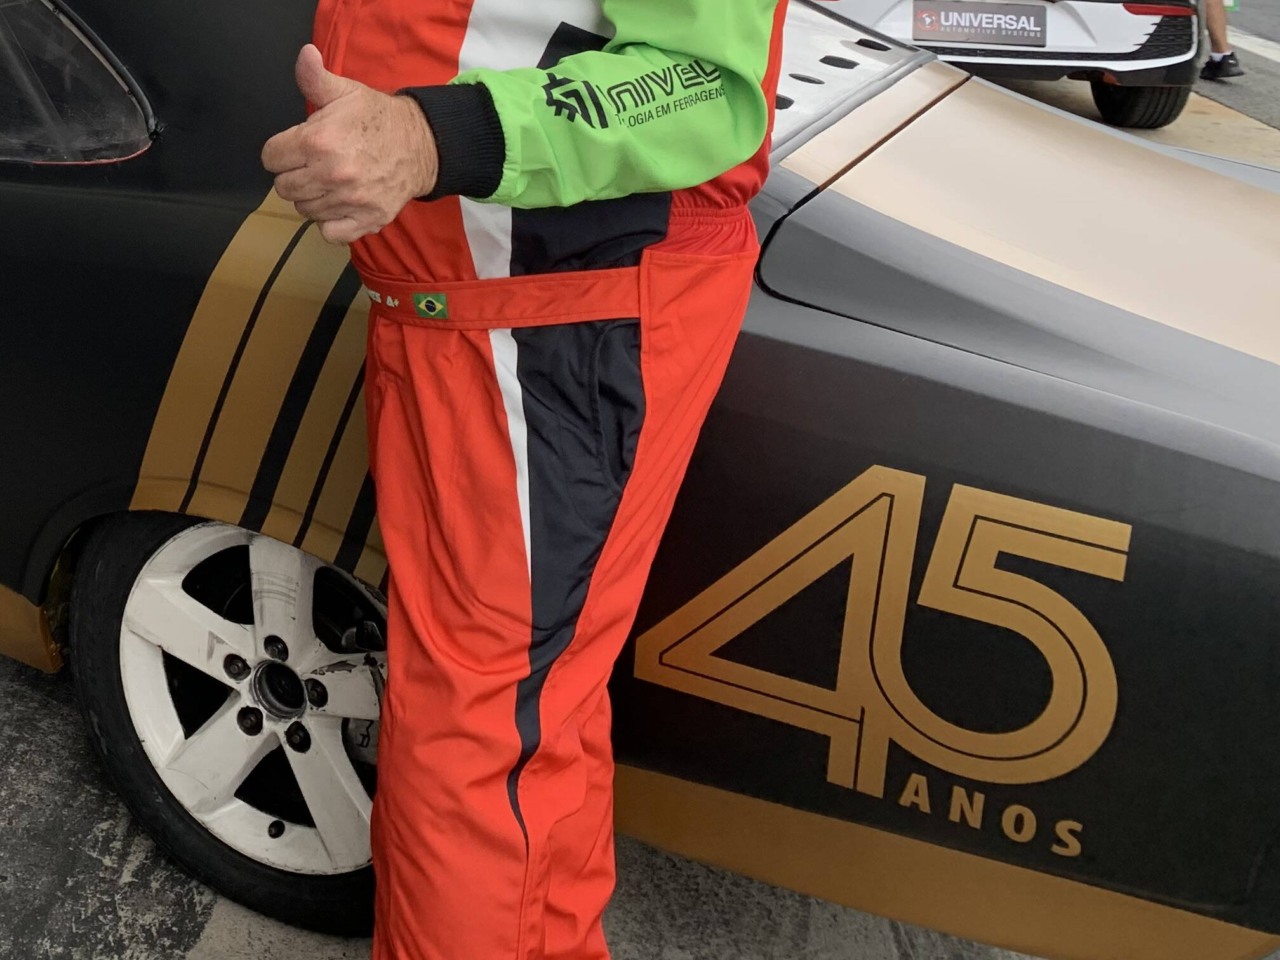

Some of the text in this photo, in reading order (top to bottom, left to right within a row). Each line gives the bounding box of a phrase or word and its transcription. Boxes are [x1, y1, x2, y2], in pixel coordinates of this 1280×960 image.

[940, 11, 1042, 31] UNIVERSAL
[656, 103, 671, 118] EM
[634, 464, 1133, 799] 45
[899, 772, 1084, 858] ANOS
